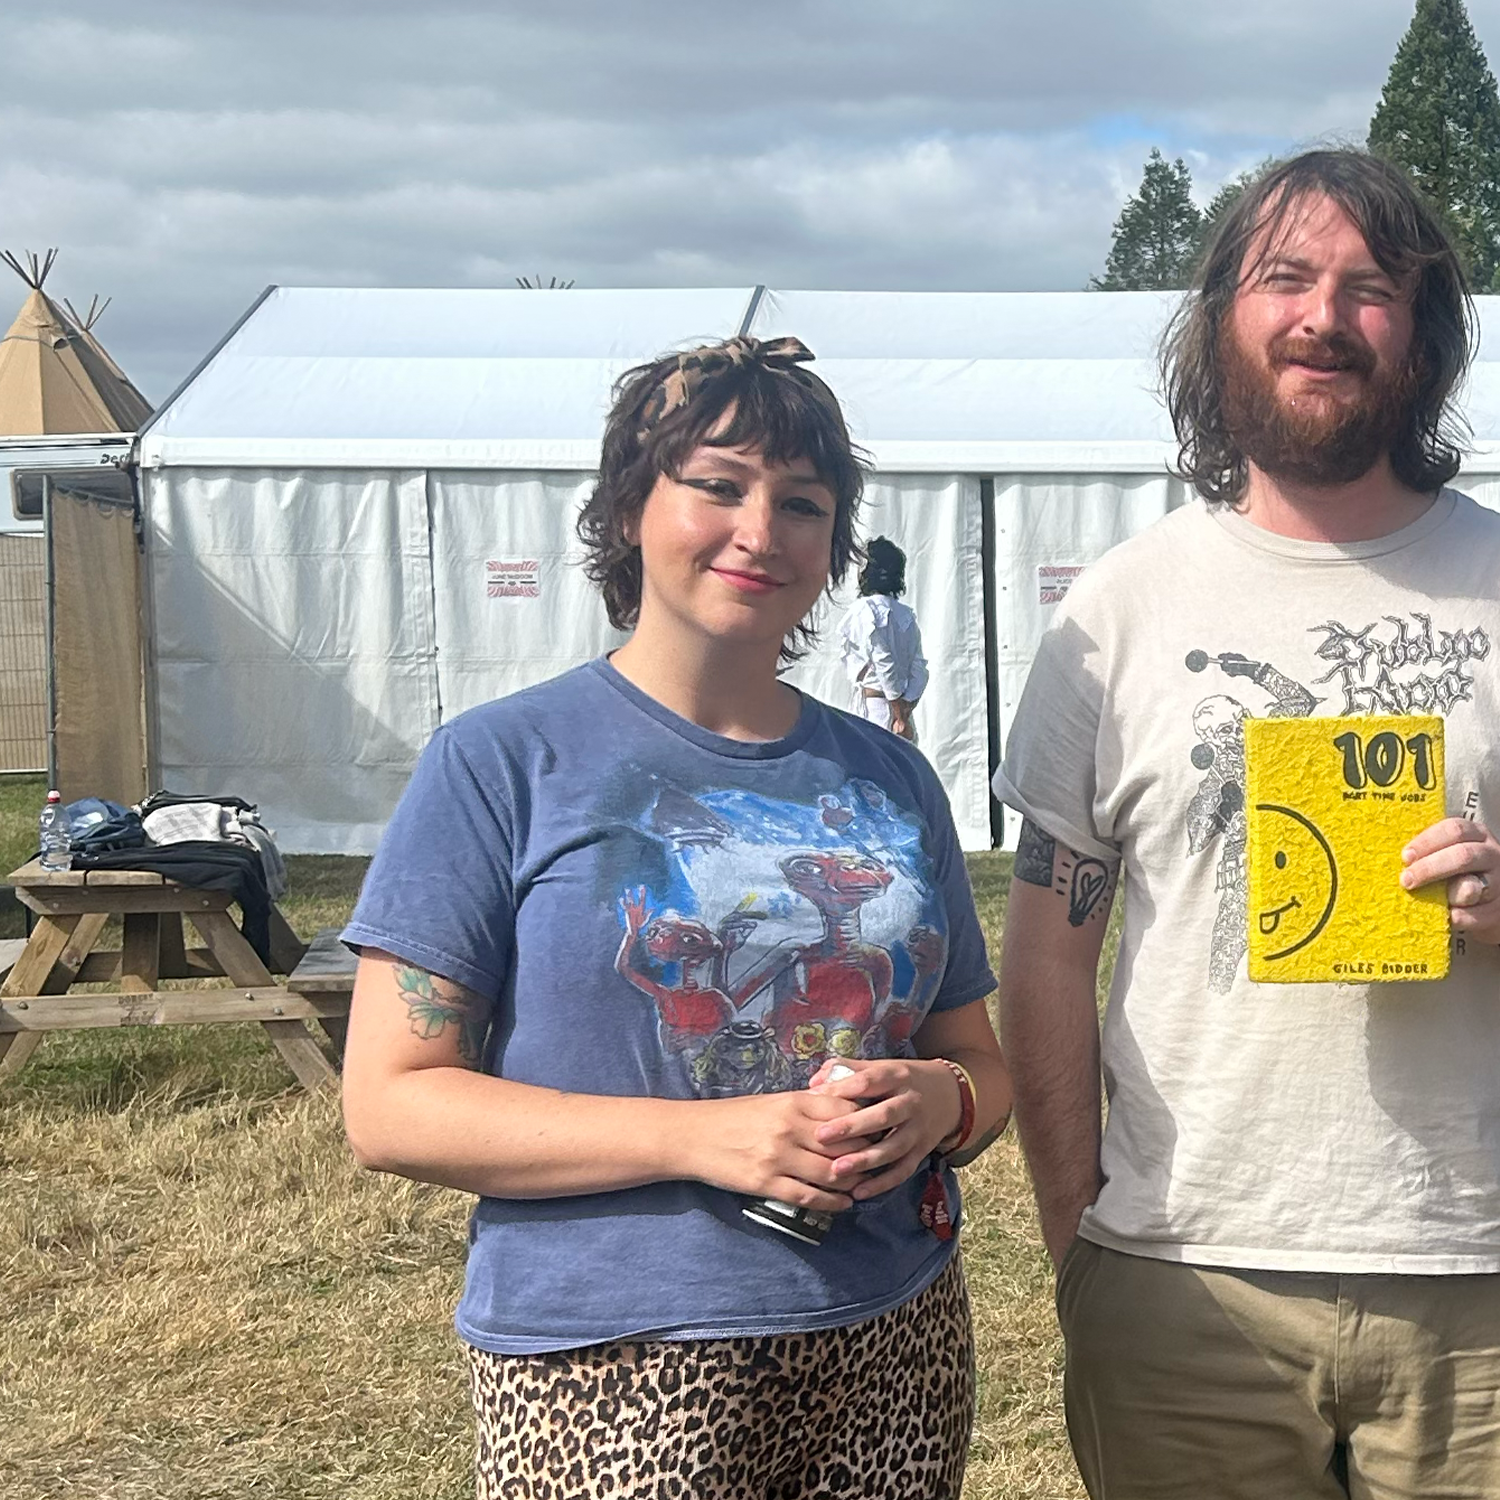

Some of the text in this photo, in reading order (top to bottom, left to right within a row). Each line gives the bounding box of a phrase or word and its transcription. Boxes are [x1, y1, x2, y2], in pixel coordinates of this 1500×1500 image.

[1333, 731, 1437, 791] 101
[1342, 791, 1426, 802] PART TIME JOBS
[1332, 963, 1428, 975] GILES BIDDER
